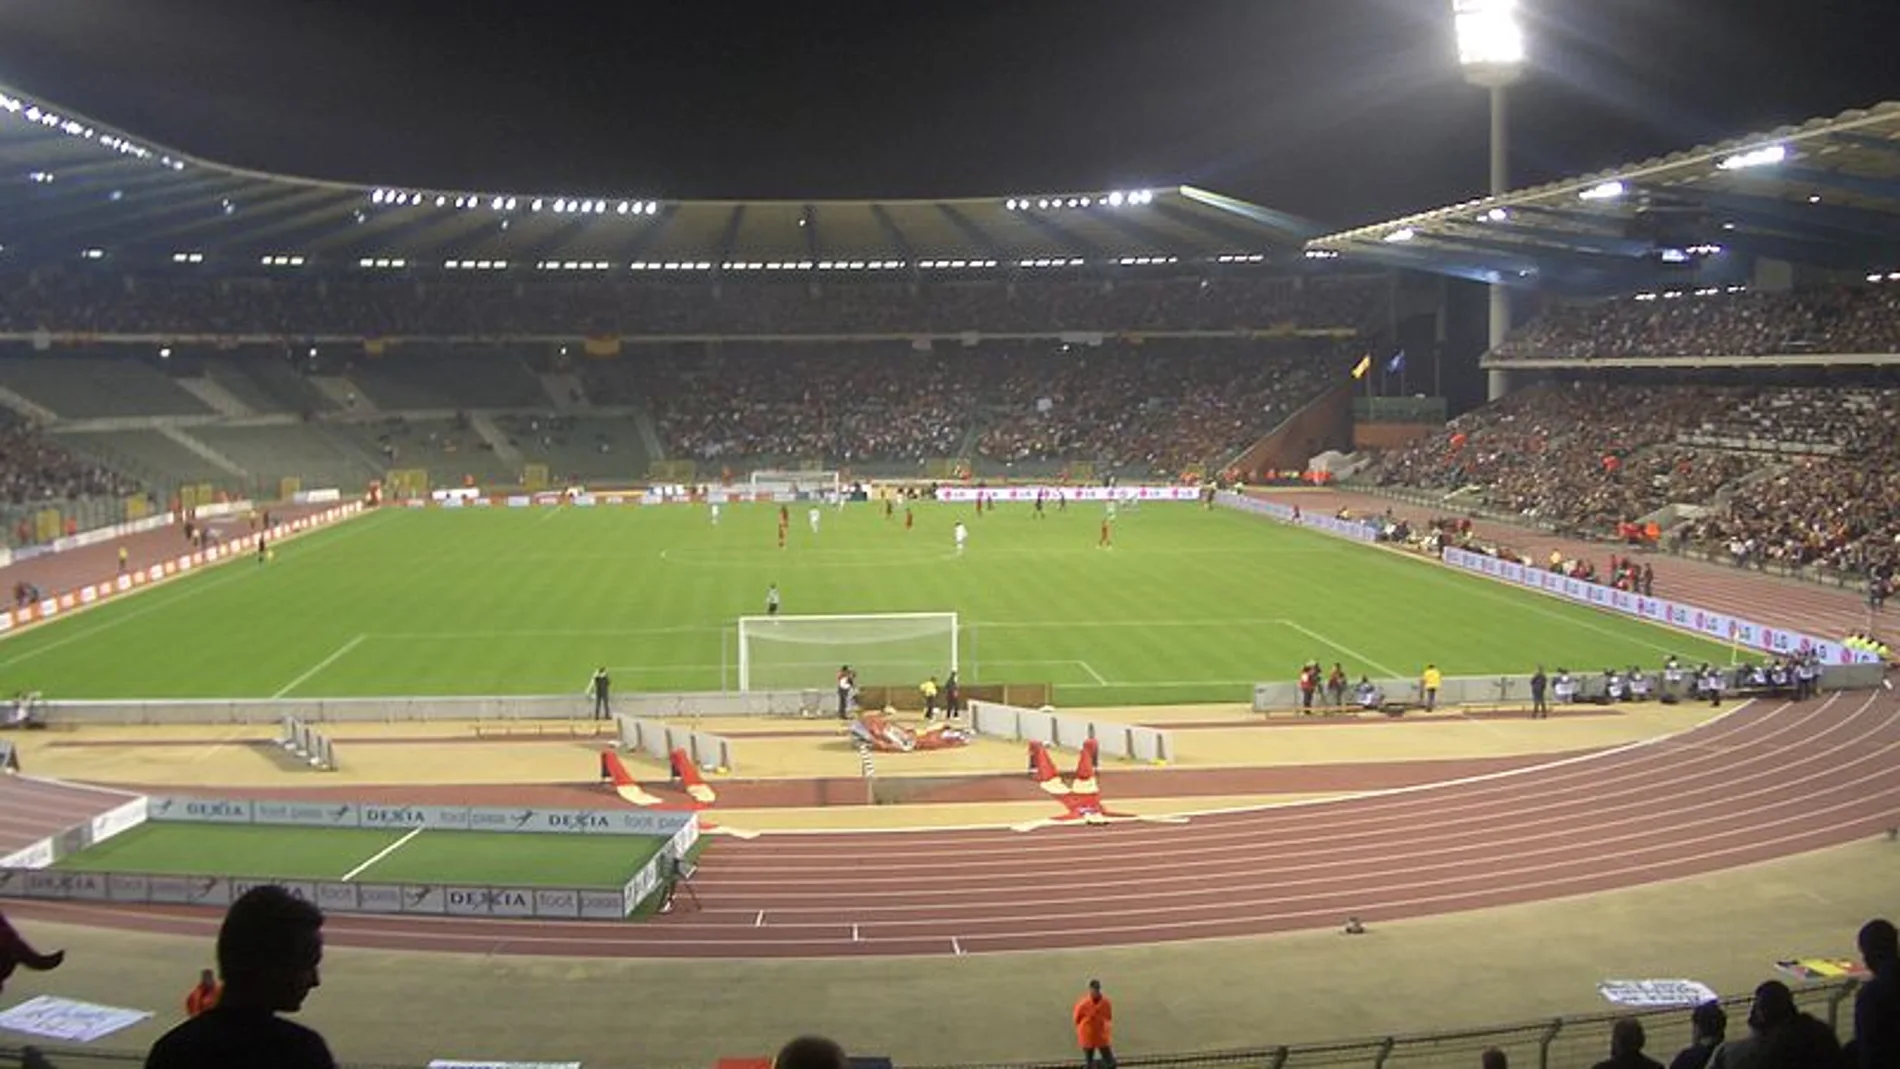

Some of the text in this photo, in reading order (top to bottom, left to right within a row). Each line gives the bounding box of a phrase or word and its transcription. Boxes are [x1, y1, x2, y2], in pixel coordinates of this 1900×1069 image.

[366, 808, 425, 823] DEXIA
[548, 813, 609, 828] DEXIA
[624, 814, 654, 828] foot
[450, 890, 526, 909] DEXIA
[539, 893, 574, 908] foot
